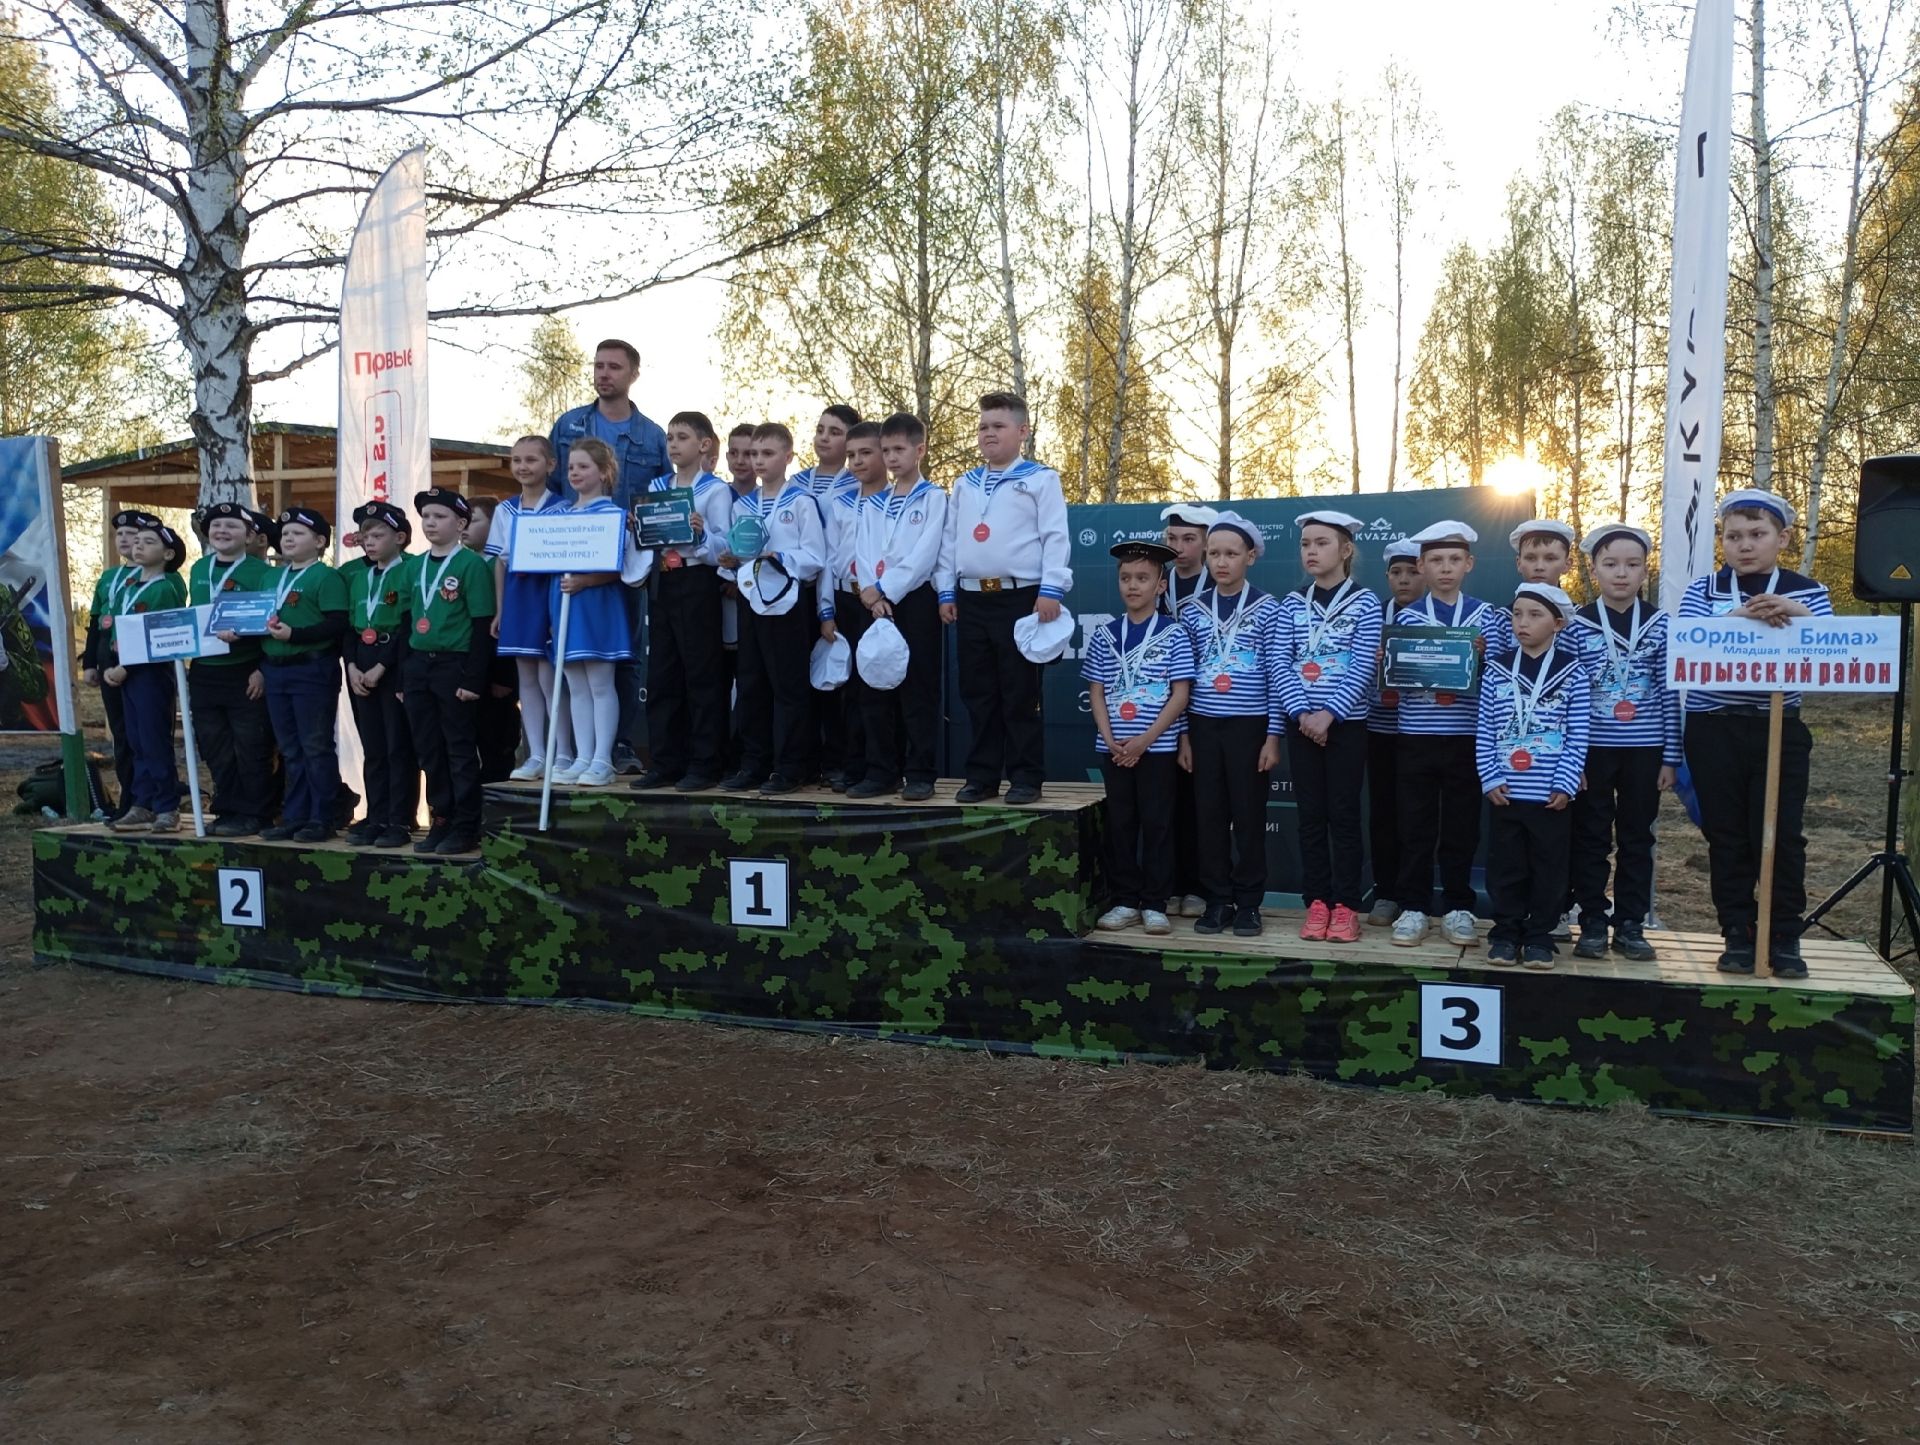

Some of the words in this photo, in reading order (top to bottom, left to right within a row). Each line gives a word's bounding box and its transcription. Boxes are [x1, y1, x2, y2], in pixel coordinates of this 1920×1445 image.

[1128, 530, 1164, 541] алабуг
[1675, 626, 1764, 648] «Орлы-
[1800, 627, 1879, 645] Бима»
[1723, 646, 1780, 656] Младшая
[1787, 647, 1848, 656] категория
[1819, 657, 1891, 686] район
[230, 877, 252, 918] 2
[745, 871, 772, 916] 1
[1440, 996, 1481, 1050] 3
